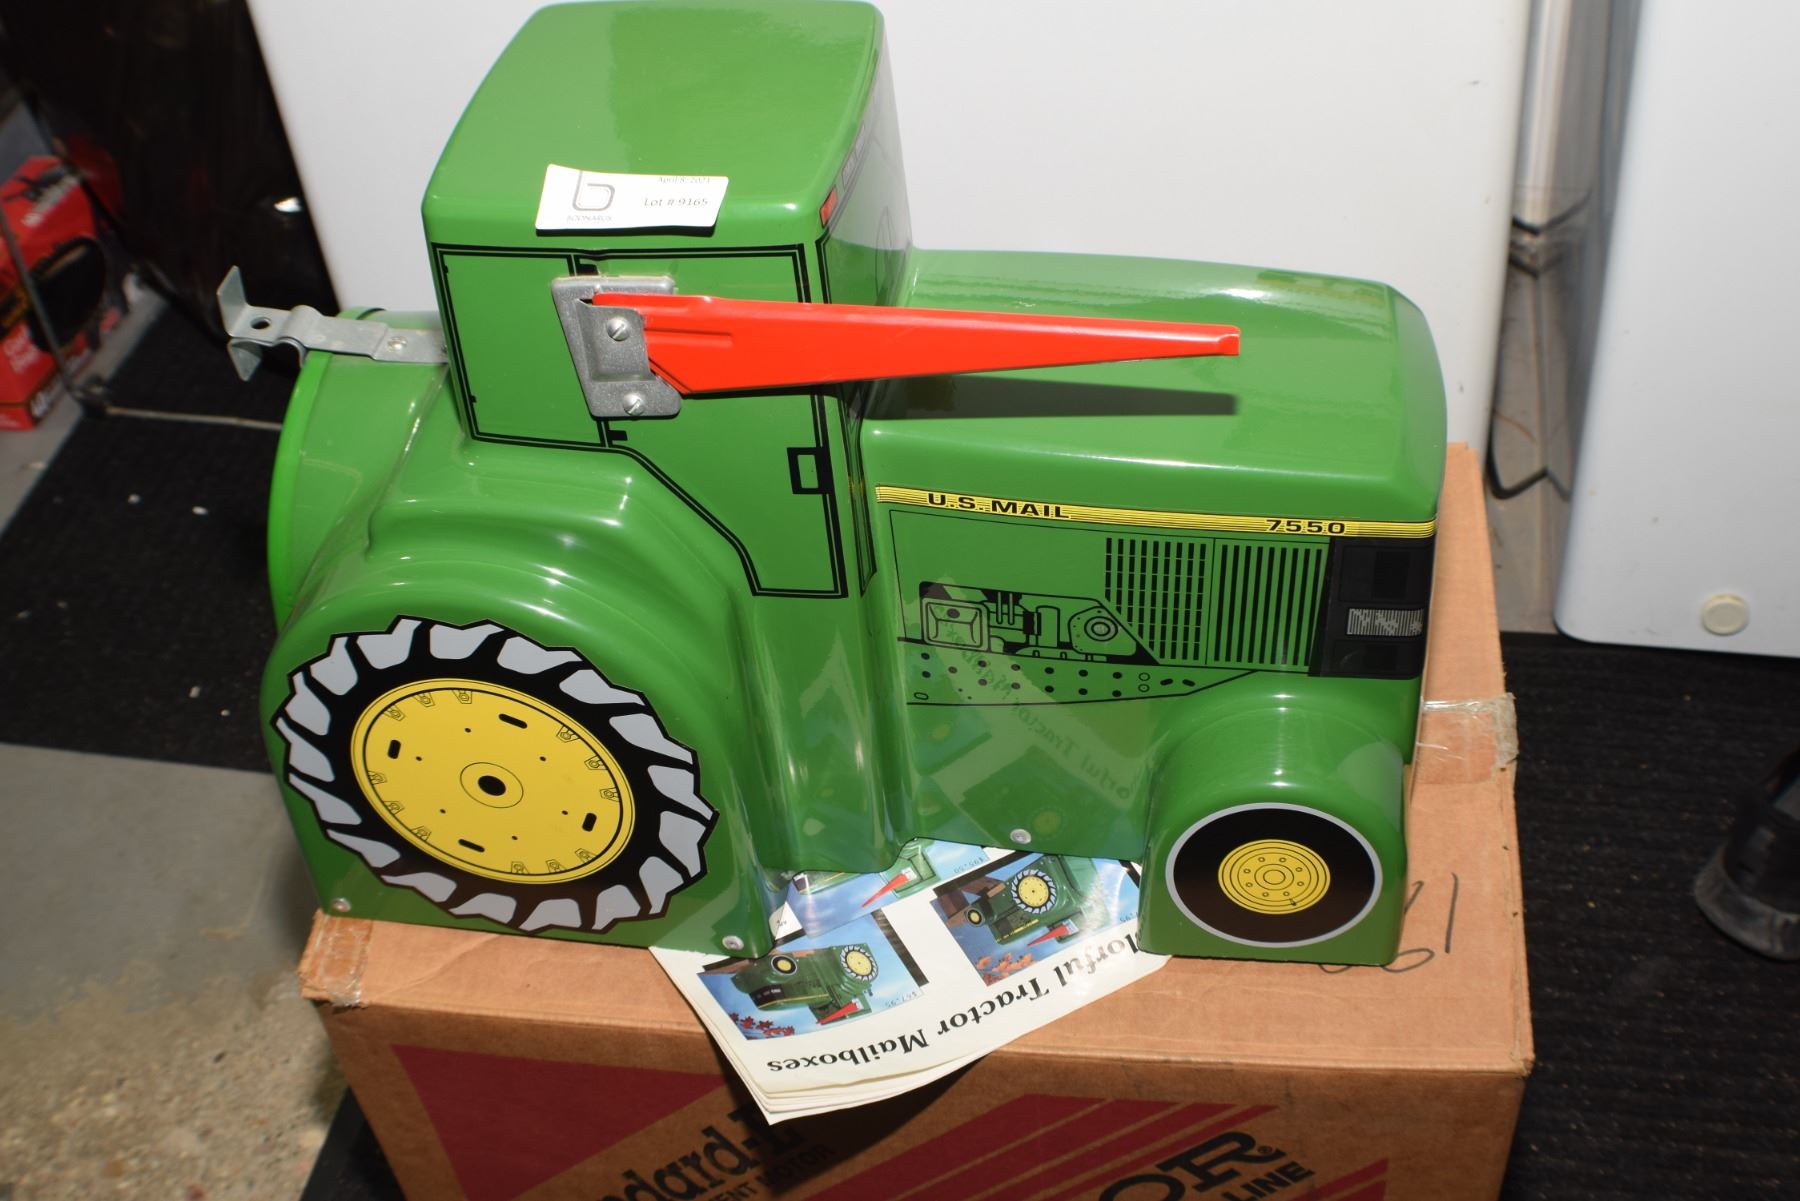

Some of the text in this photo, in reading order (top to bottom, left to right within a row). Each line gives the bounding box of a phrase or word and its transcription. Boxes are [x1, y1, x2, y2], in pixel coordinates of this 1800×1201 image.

[644, 197, 709, 207] Lot # 9165
[1266, 520, 1345, 534] 7550
[766, 933, 1140, 1073] lorful Tractor Mailboxes
[1220, 1161, 1315, 1201] LINE
